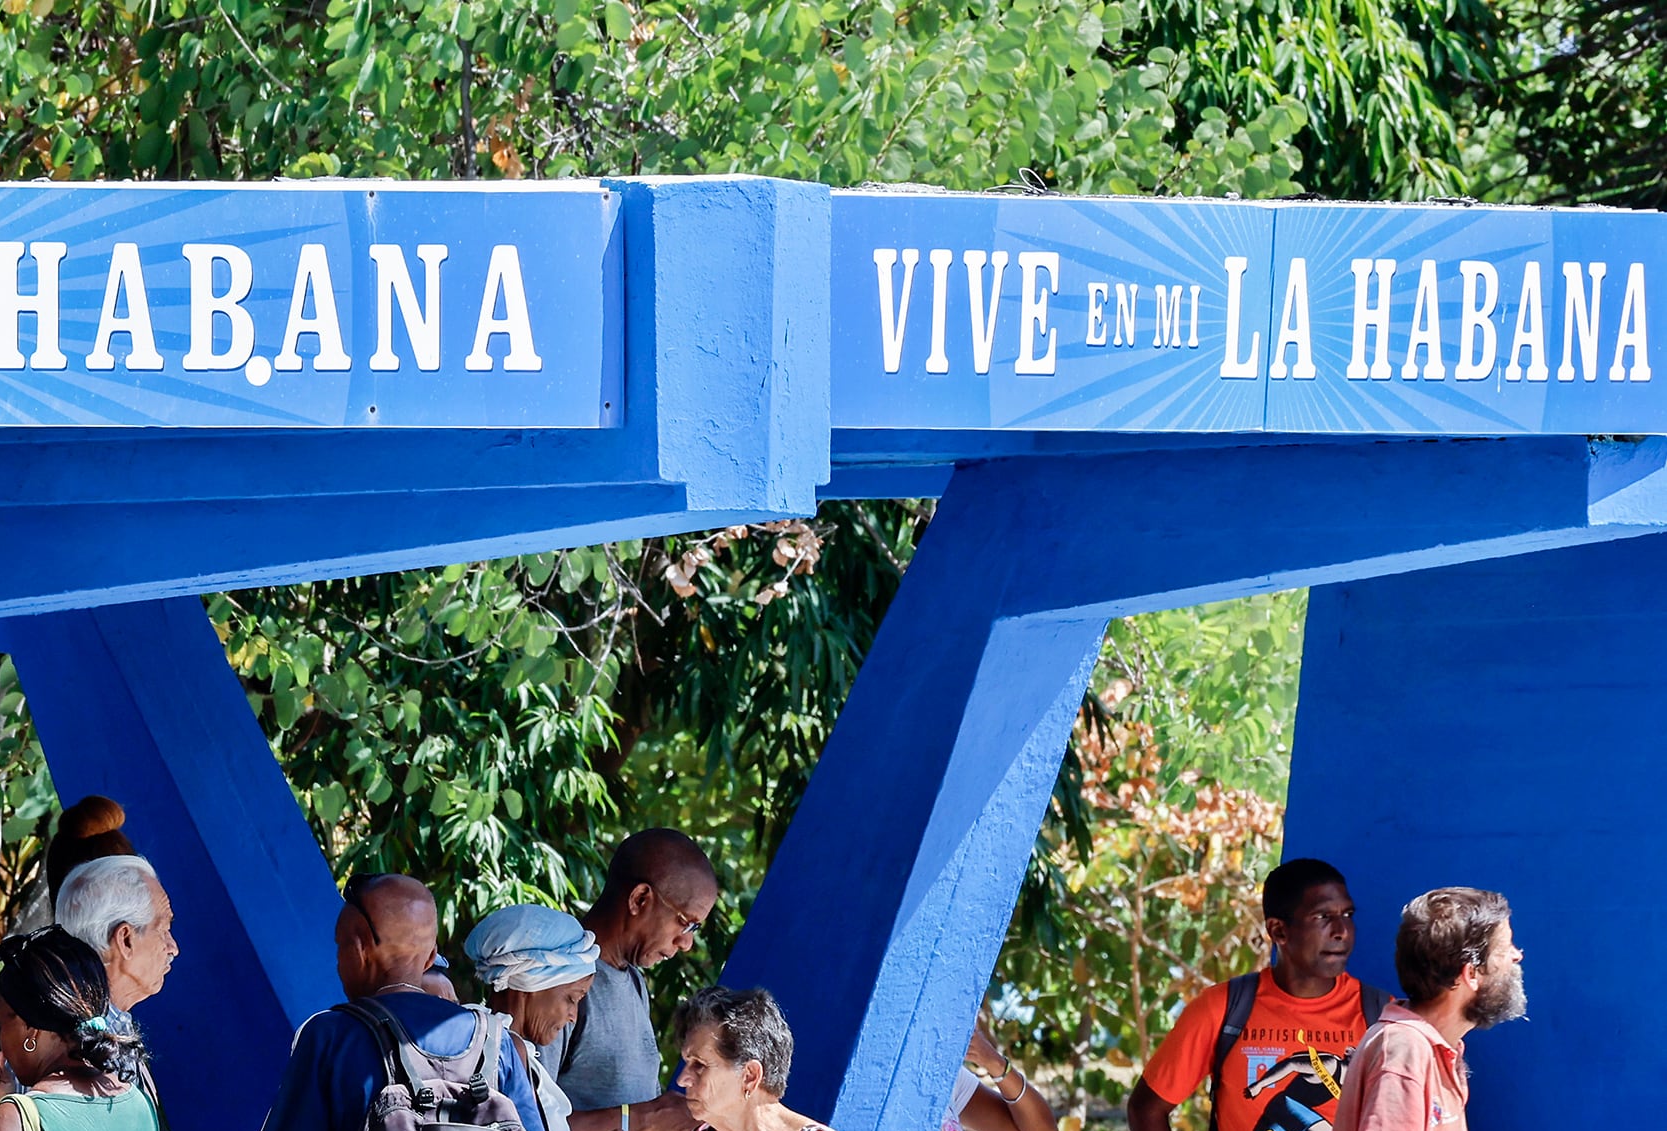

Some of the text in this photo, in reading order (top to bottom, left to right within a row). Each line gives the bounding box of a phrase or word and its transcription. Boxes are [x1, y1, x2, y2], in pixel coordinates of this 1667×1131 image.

[872, 248, 1652, 381] VIVE EN MI LA HABANA
[1243, 1028, 1354, 1043] BAPTIST HEALTH
[1311, 1056, 1322, 1074] Tour
